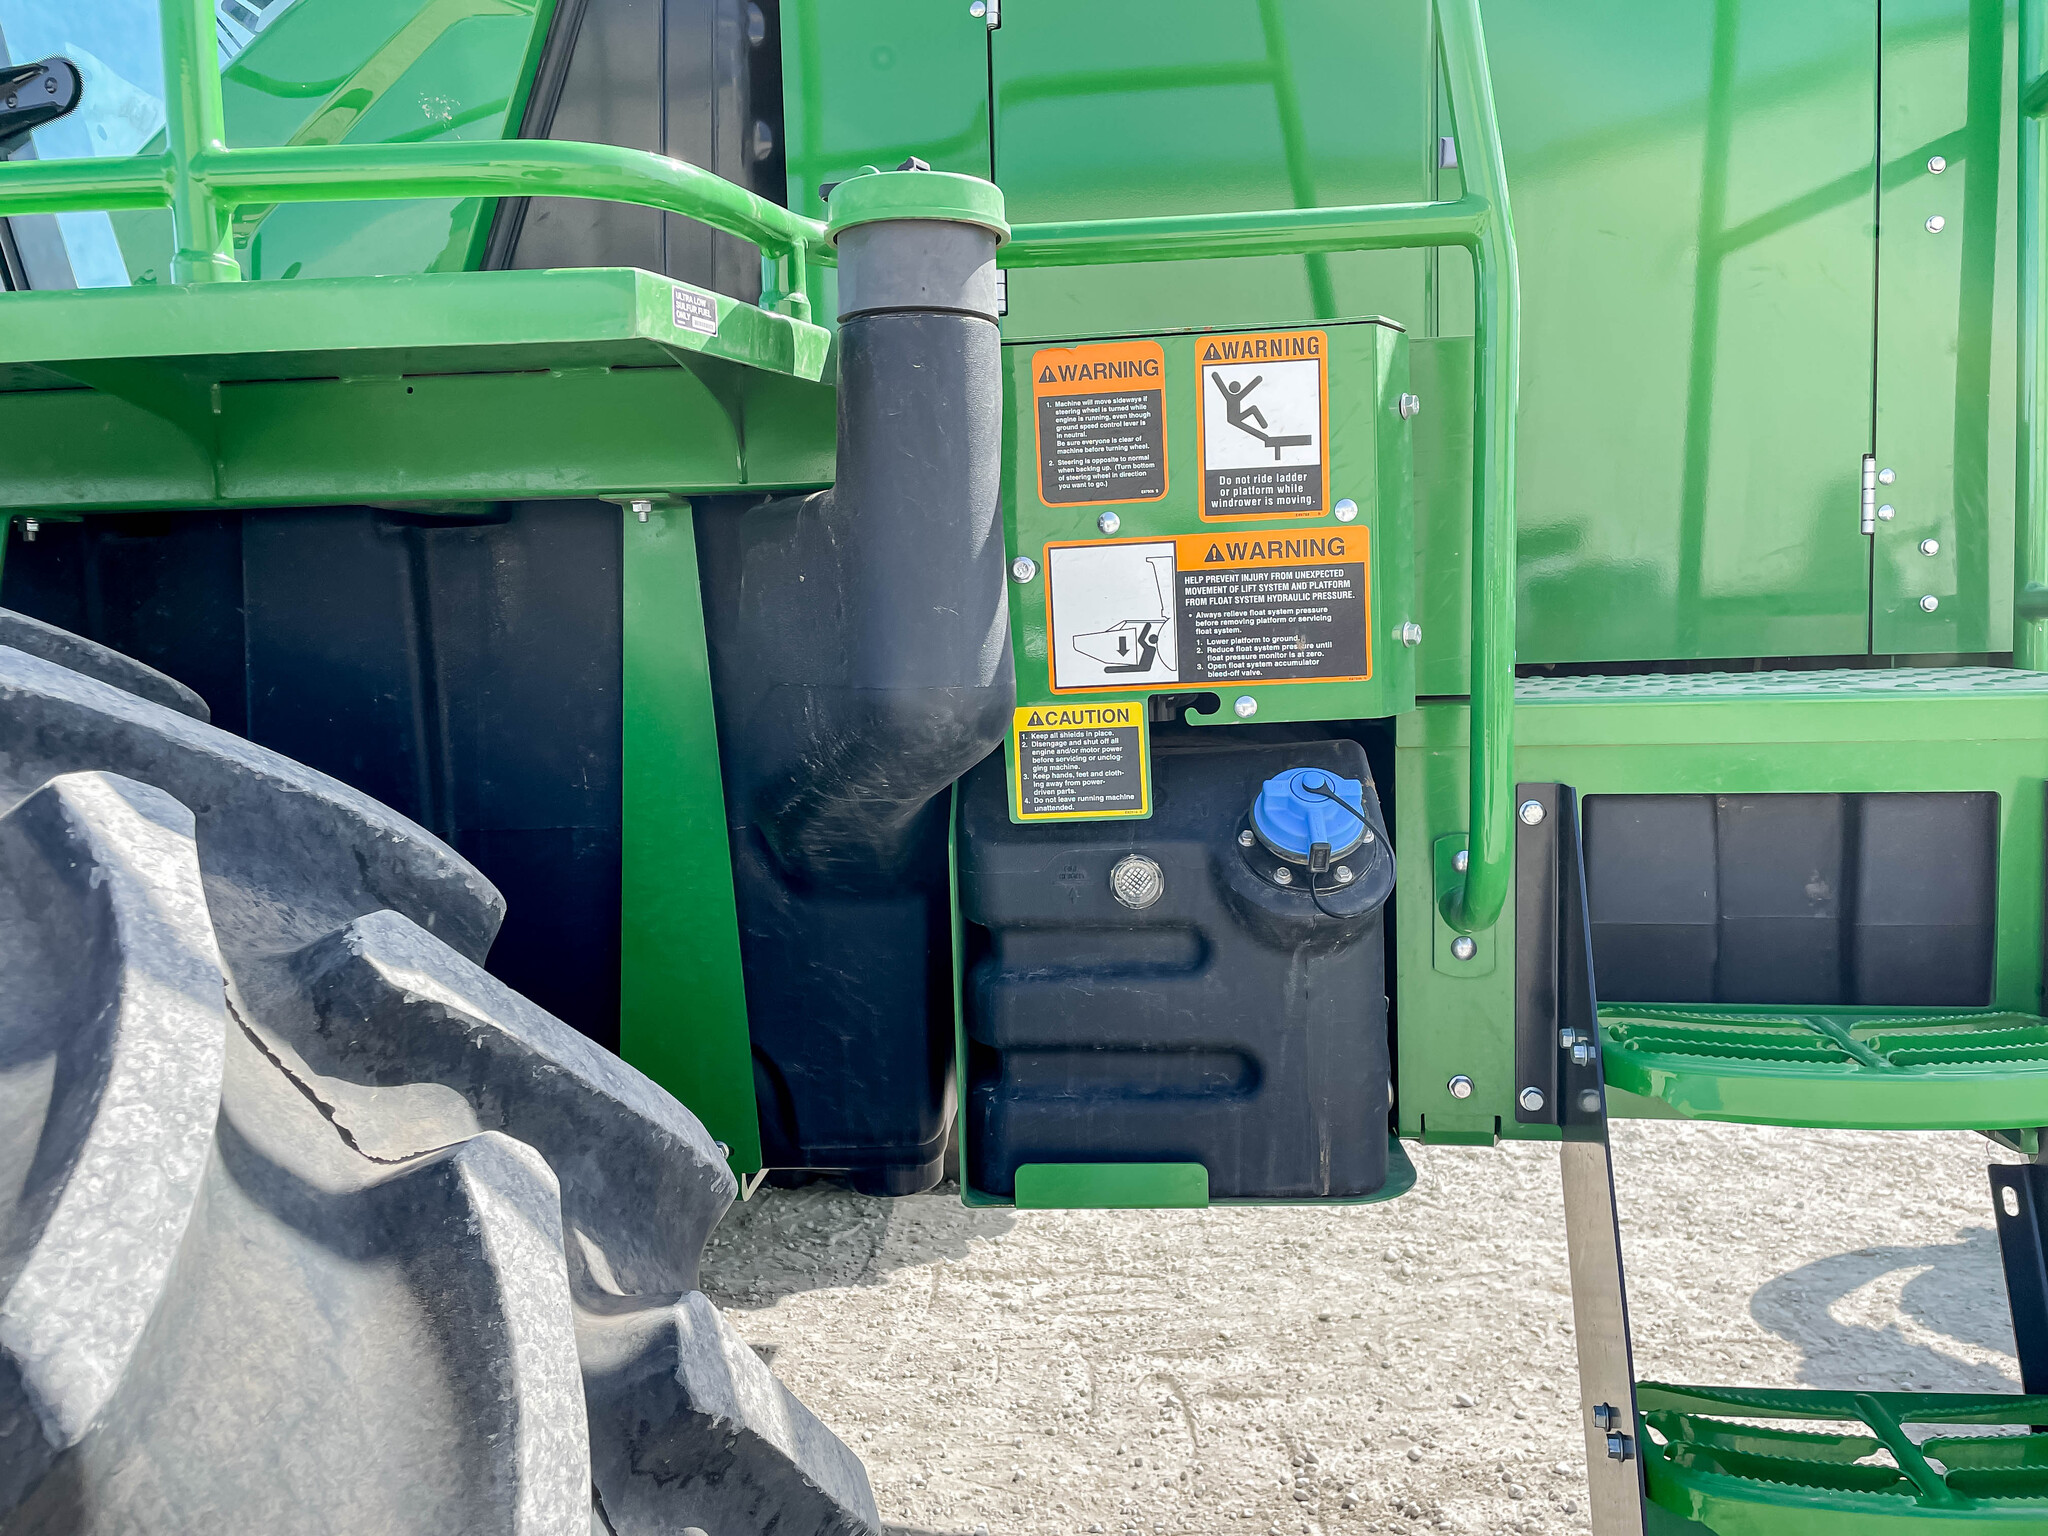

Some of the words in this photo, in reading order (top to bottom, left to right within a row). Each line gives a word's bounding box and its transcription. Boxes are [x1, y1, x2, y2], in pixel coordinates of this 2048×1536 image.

[676, 291, 693, 304] ULTRA
[694, 297, 706, 307] LOW
[676, 301, 697, 314] SULFUR
[698, 307, 711, 318] FUEL
[676, 310, 691, 320] ONLY
[1221, 336, 1319, 360] WARNING
[1058, 359, 1159, 382] WARNING
[1129, 411, 1151, 419] though
[1056, 424, 1078, 432] ground
[1080, 422, 1098, 430] speed
[1219, 476, 1231, 485] Do
[1236, 475, 1250, 484] not
[1254, 474, 1272, 483] ride
[1276, 472, 1307, 482] ladder
[1096, 480, 1108, 488] go.)
[1233, 486, 1273, 497] platform
[1277, 484, 1303, 493] while
[1211, 498, 1261, 508] windrower
[1265, 496, 1273, 505] is
[1277, 495, 1315, 505] moving.
[1226, 537, 1345, 561] WARNING
[1185, 576, 1204, 584] HELP
[1206, 574, 1239, 583] PREVENT
[1241, 573, 1269, 582] INJURY
[1271, 571, 1293, 580] FROM
[1295, 569, 1344, 579] UNEXPECTED
[1185, 586, 1227, 595] MOVEMENT
[1229, 585, 1239, 593] OF
[1241, 584, 1257, 592] LIFT
[1259, 583, 1289, 592] SYSTEM
[1291, 582, 1308, 590] AND
[1309, 580, 1350, 589] PLATFORM
[1185, 598, 1207, 606] FROM
[1209, 596, 1233, 605] FLOAT
[1234, 595, 1265, 604] SYSTEM
[1267, 593, 1310, 602] HYDRAULIC
[1312, 591, 1355, 600] PRESSURE.
[1296, 607, 1328, 615] pressure
[1256, 617, 1286, 625] platform
[1214, 627, 1242, 635] system.
[1231, 637, 1261, 645] platform
[1225, 654, 1257, 662] pressure
[1246, 661, 1273, 669] system
[1274, 659, 1319, 667] accumulator
[1045, 708, 1129, 725] CAUTION
[1094, 730, 1114, 738] place.
[1032, 748, 1055, 756] engine
[1056, 755, 1087, 763] servicing
[1033, 765, 1048, 773] ging
[1057, 788, 1076, 796] parts.
